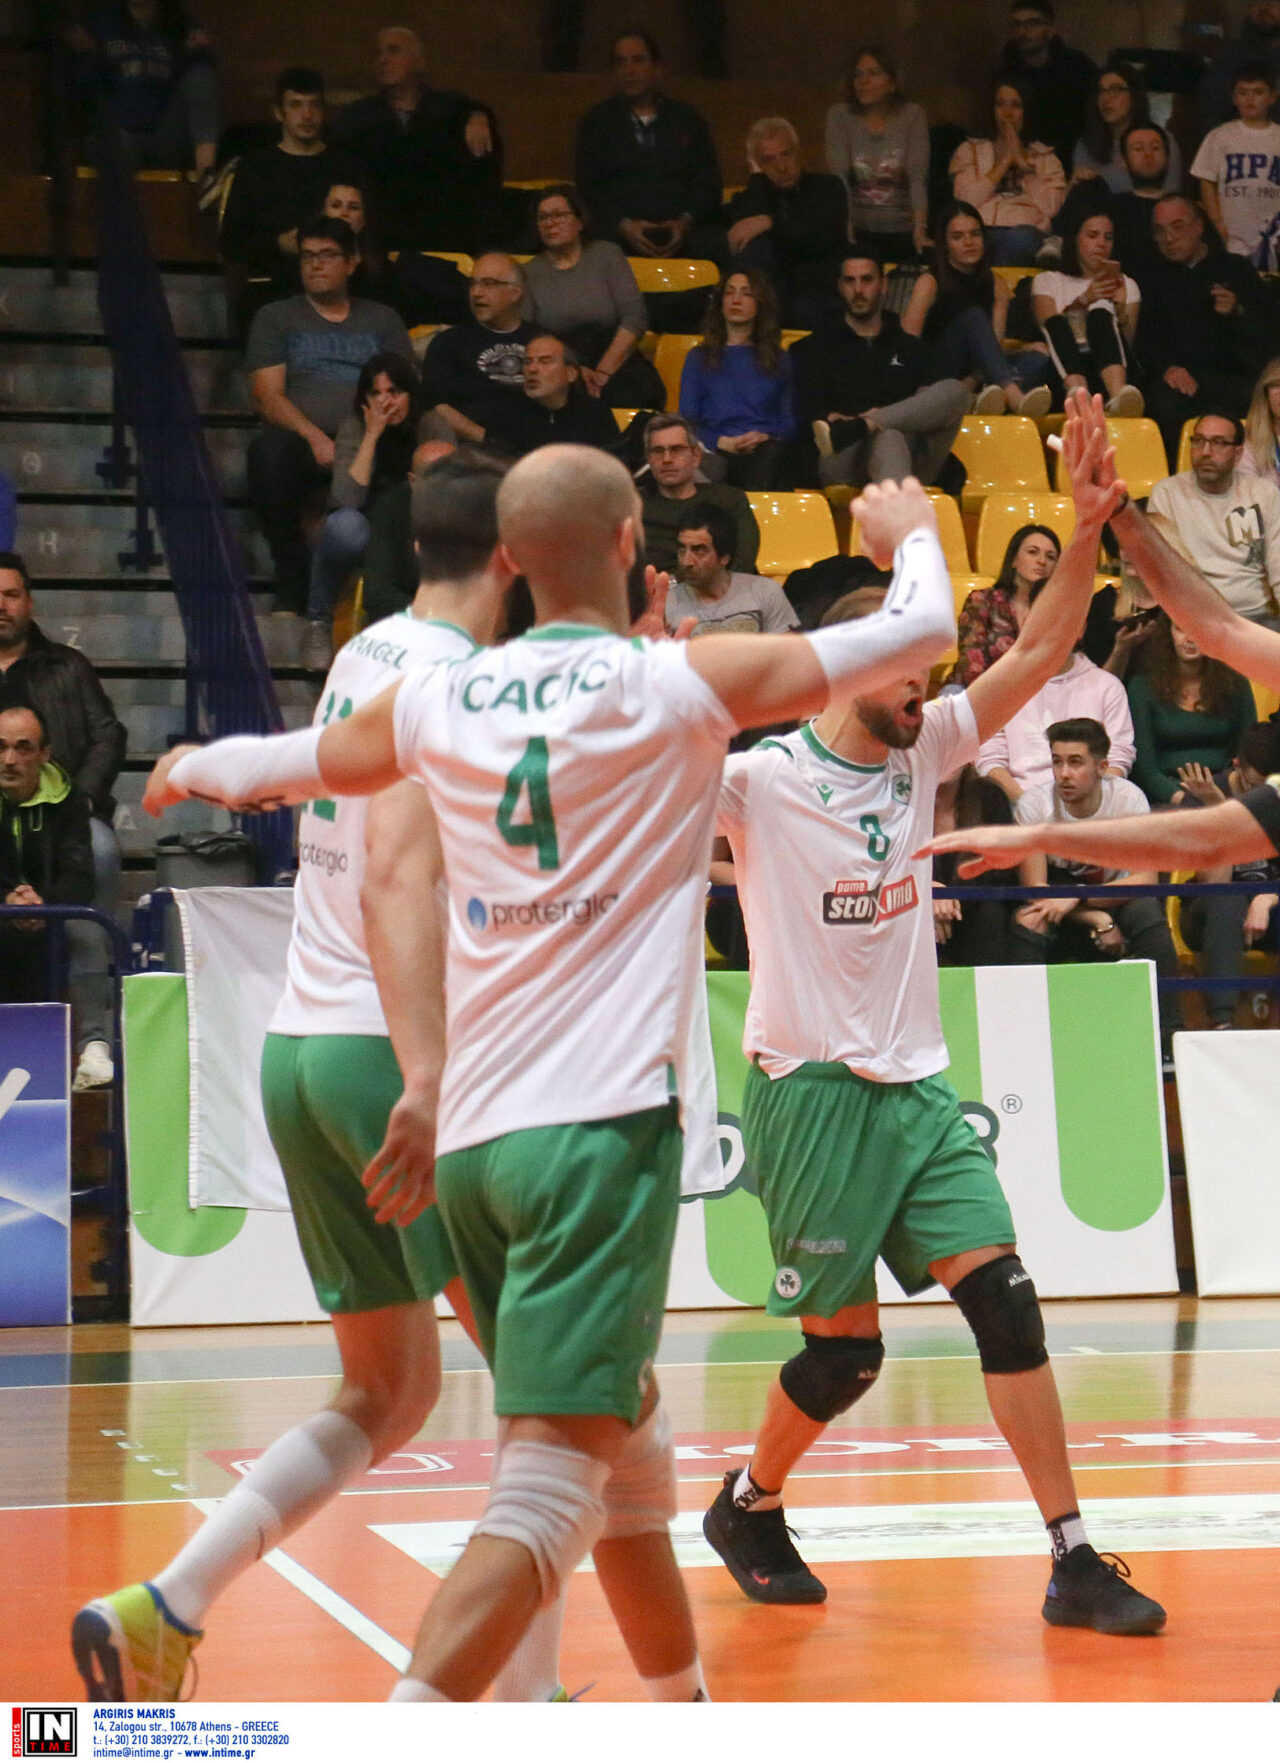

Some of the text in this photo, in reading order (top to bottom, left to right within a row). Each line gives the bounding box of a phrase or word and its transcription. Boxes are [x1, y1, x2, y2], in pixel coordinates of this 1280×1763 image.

[348, 635, 409, 669] ANGEL
[495, 735, 559, 871] 4
[859, 814, 891, 862] 8
[300, 843, 348, 877] rotergia
[837, 882, 866, 895] pame
[1252, 993, 1270, 1020] 6
